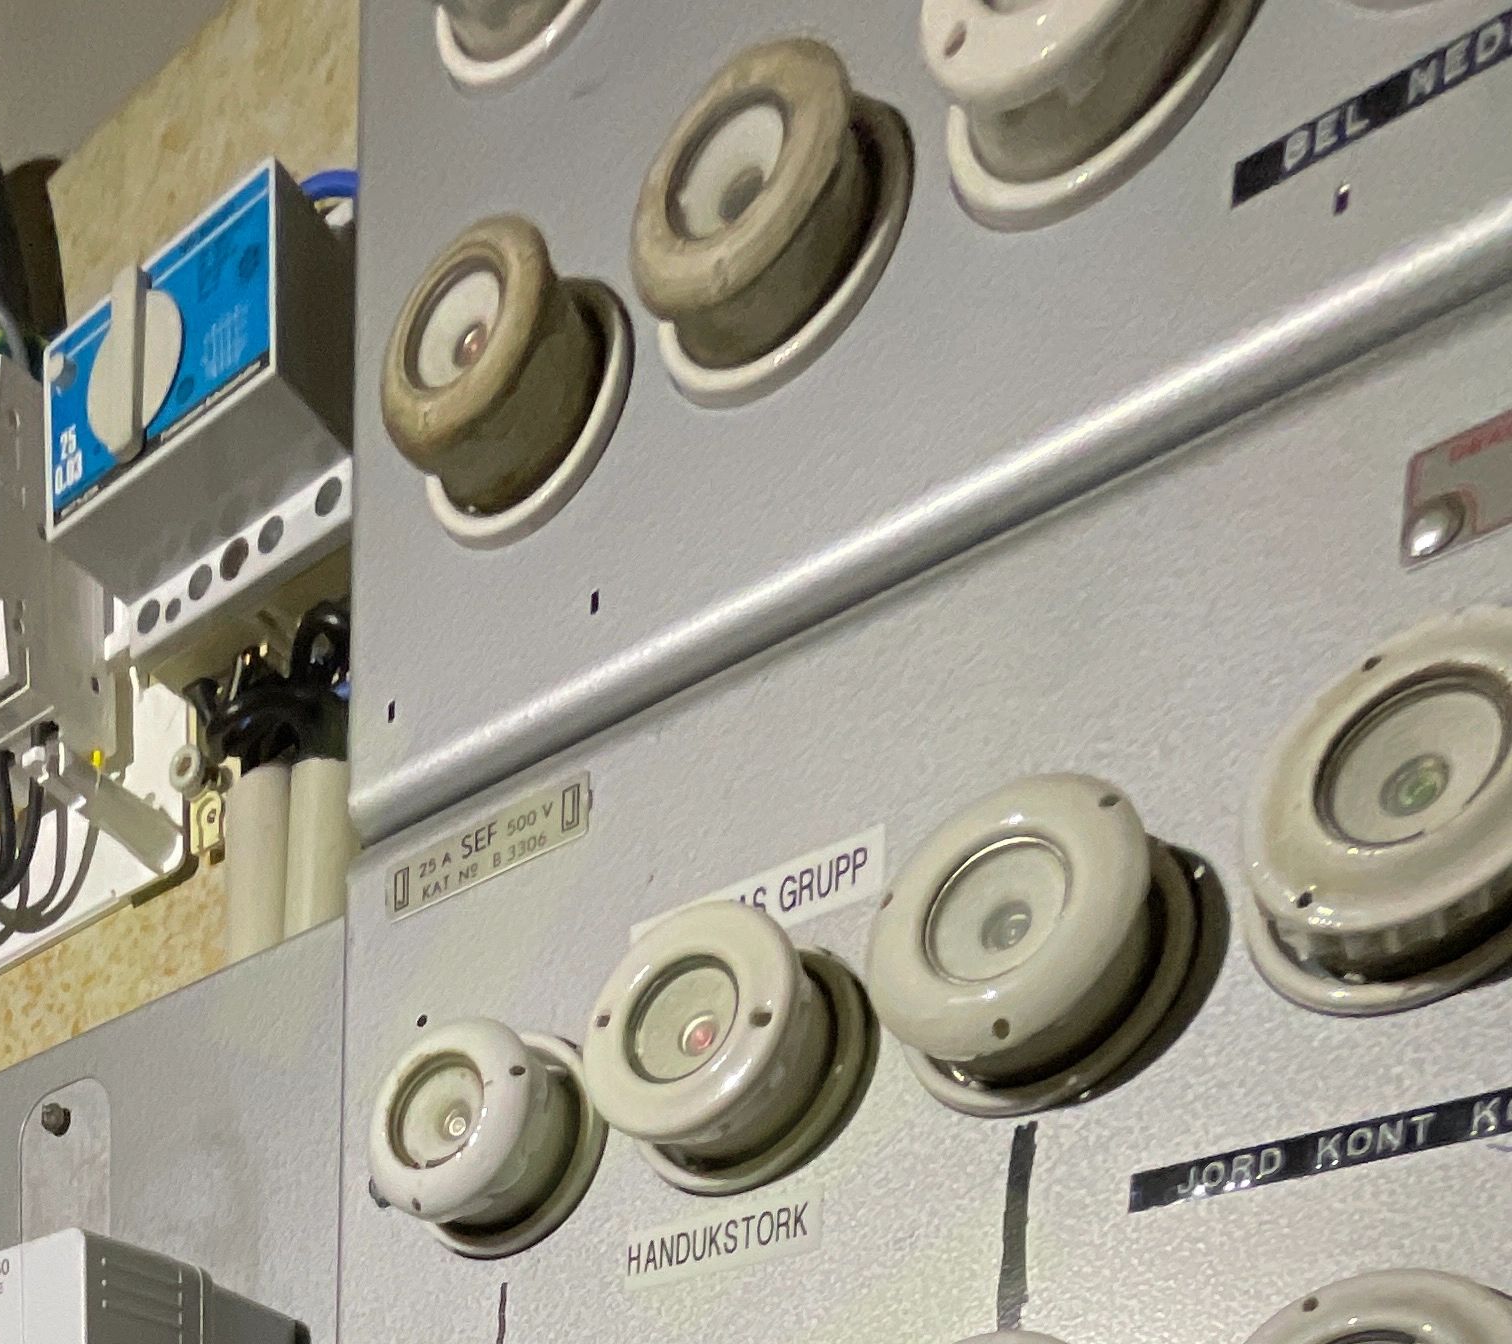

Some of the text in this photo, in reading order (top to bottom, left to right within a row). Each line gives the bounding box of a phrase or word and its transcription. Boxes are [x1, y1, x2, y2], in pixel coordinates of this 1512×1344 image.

[1407, 20, 1512, 105] NED
[441, 852, 452, 868] A
[460, 820, 498, 860] SEF
[507, 810, 537, 837] 500
[541, 801, 554, 818] V
[421, 874, 450, 901] KAT
[778, 846, 868, 913] GRUPP
[1176, 1146, 1283, 1196] JORD
[1315, 1111, 1438, 1170] KONT
[626, 1202, 810, 1277] HANDUKSTORK
